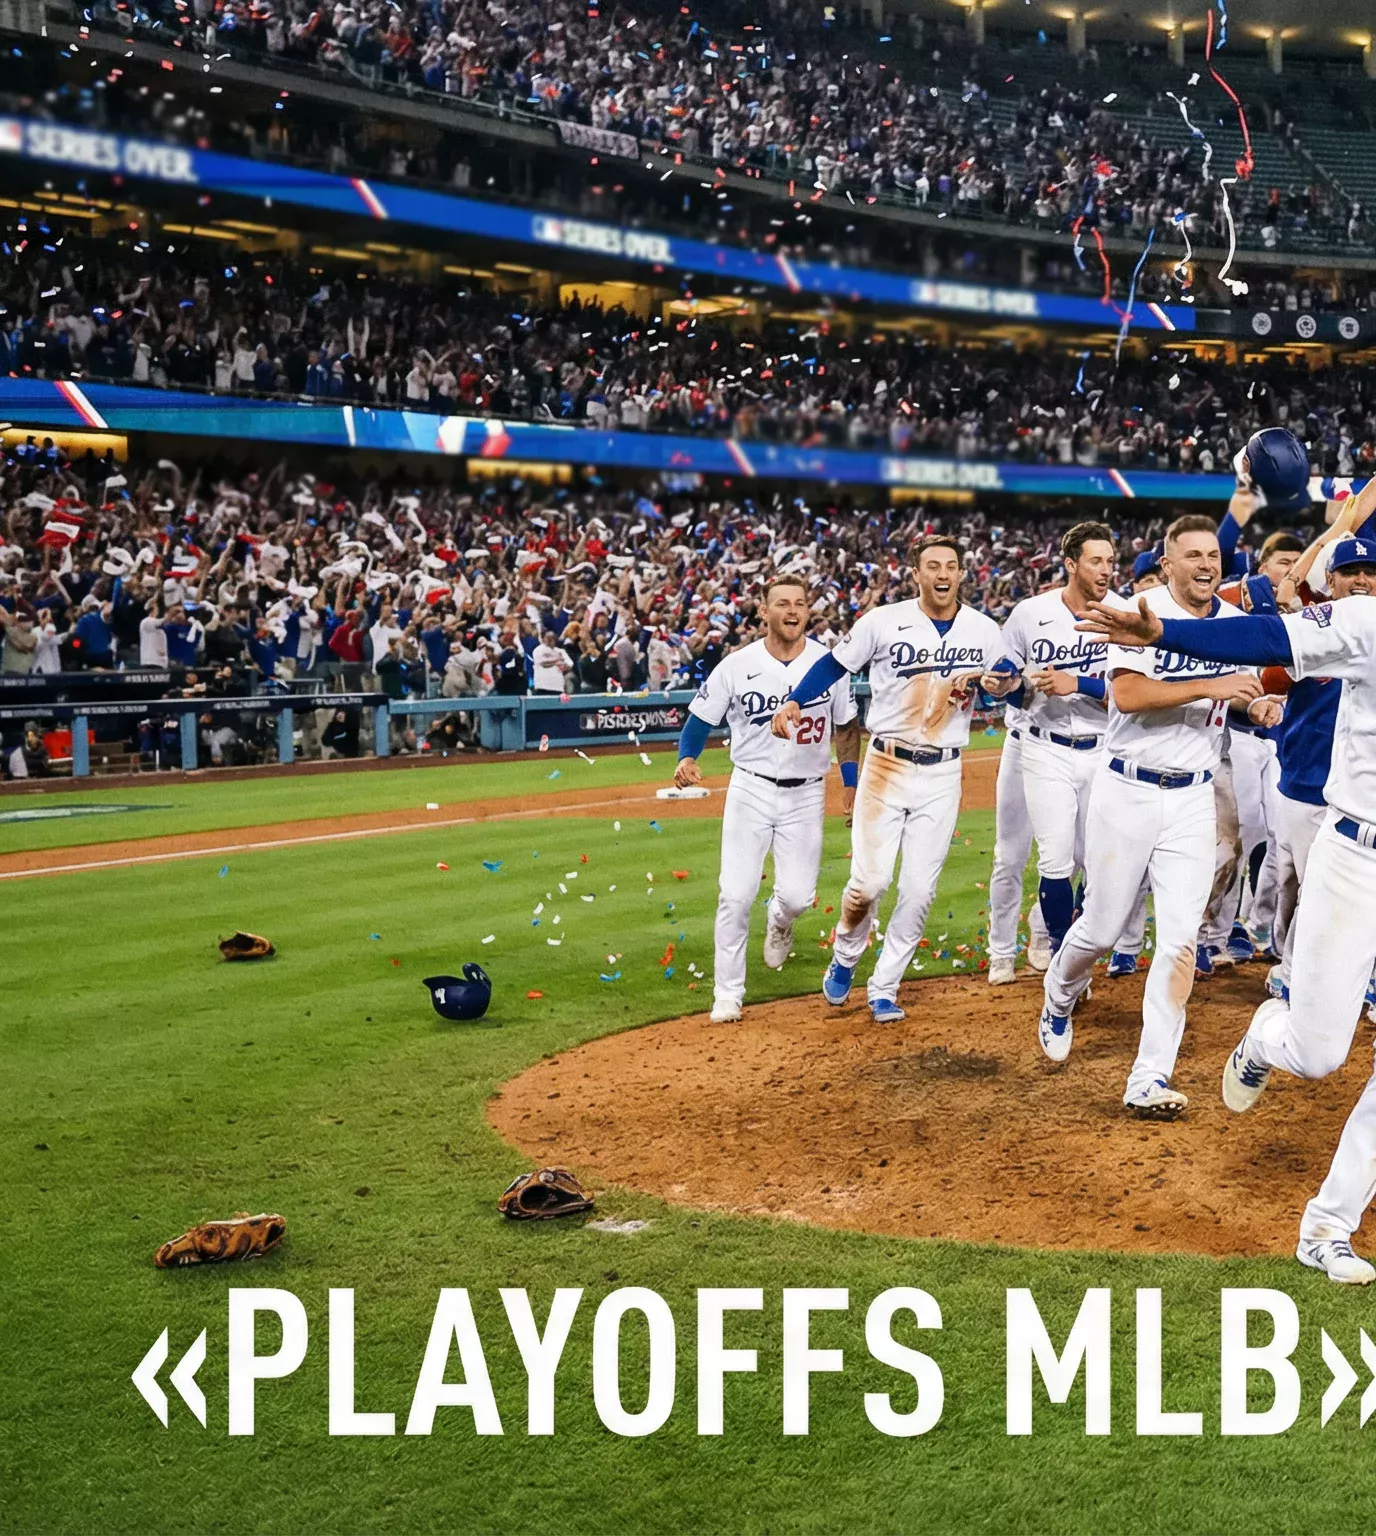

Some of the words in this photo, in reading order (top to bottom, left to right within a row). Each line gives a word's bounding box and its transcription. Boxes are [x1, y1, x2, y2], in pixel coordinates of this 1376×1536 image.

[28, 122, 119, 170] SERIES
[889, 641, 983, 678] Dodgers
[1031, 635, 1108, 673] Dodge
[797, 716, 826, 745] 29
